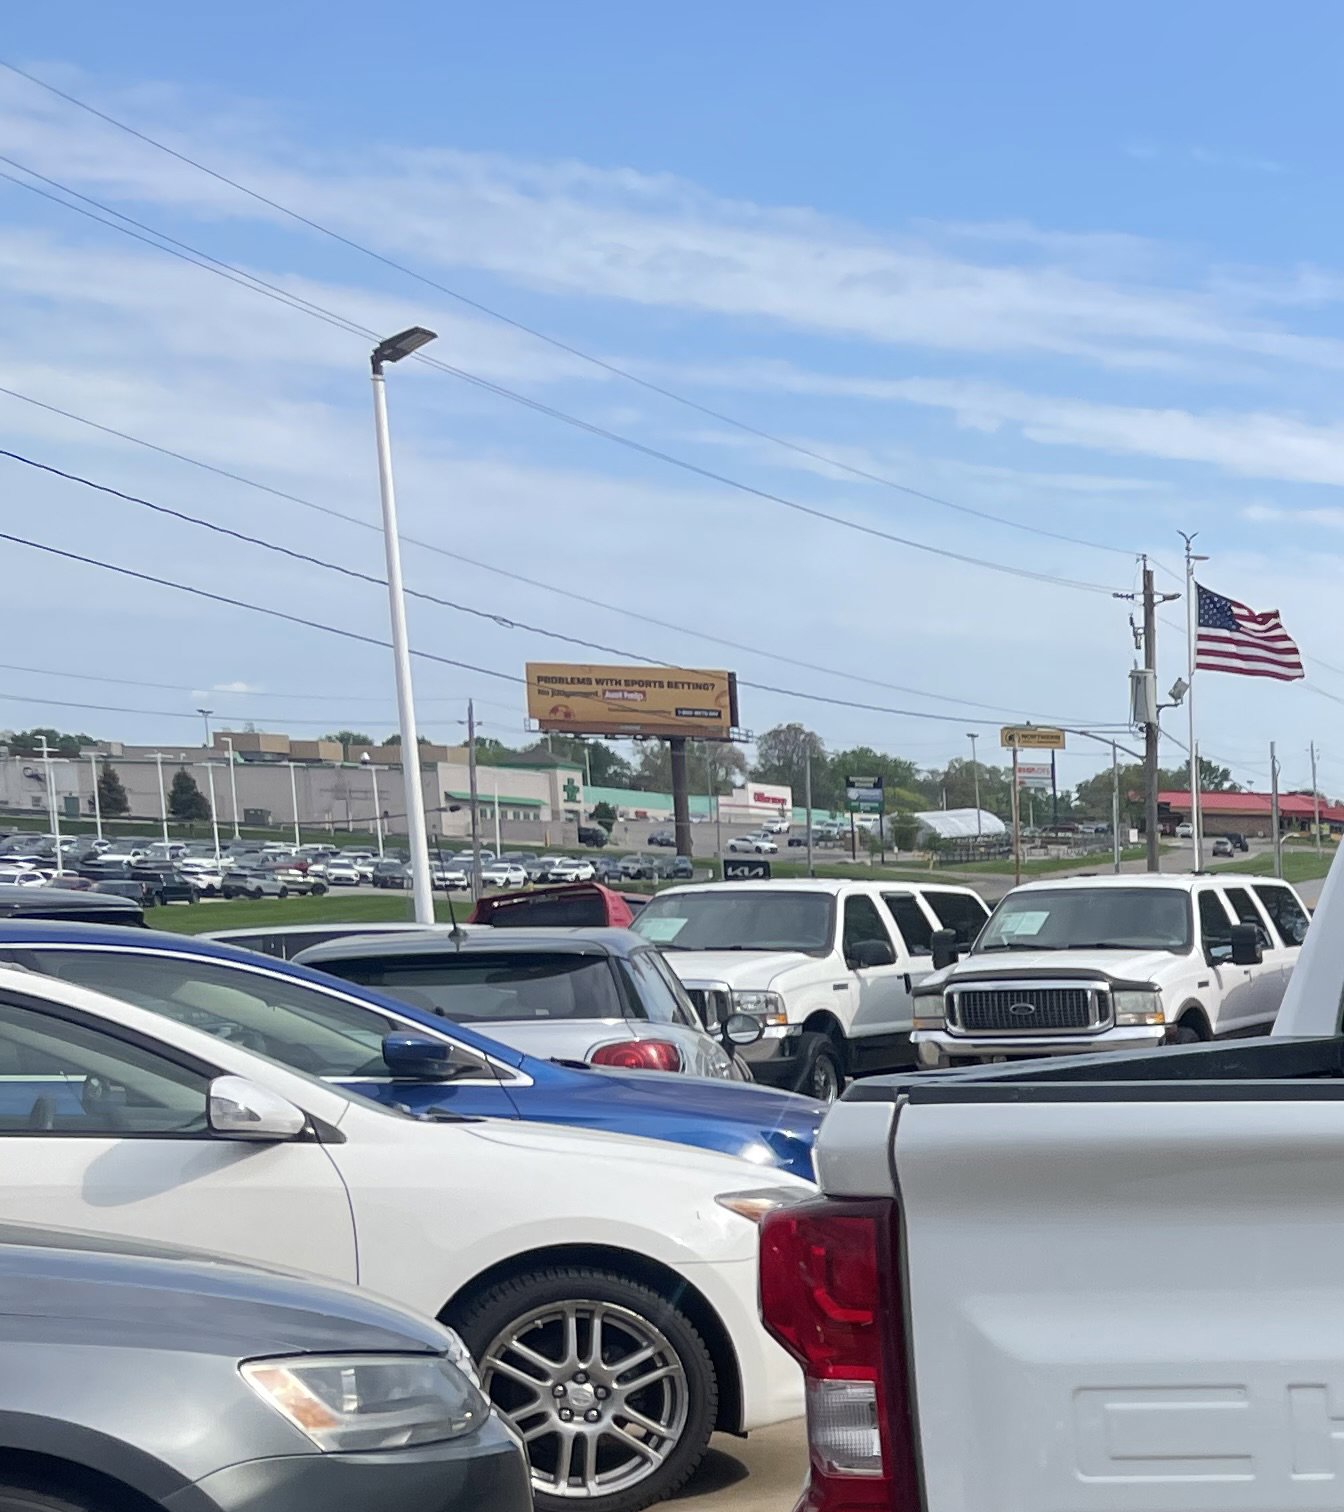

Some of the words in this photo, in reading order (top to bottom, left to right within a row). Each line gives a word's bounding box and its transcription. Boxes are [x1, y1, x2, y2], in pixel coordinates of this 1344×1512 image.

[536, 675, 593, 686] PROBLEMS
[594, 678, 622, 687] WITH
[624, 679, 665, 690] SPORTS
[667, 680, 715, 691] BETTING?
[727, 866, 764, 877] KIA
